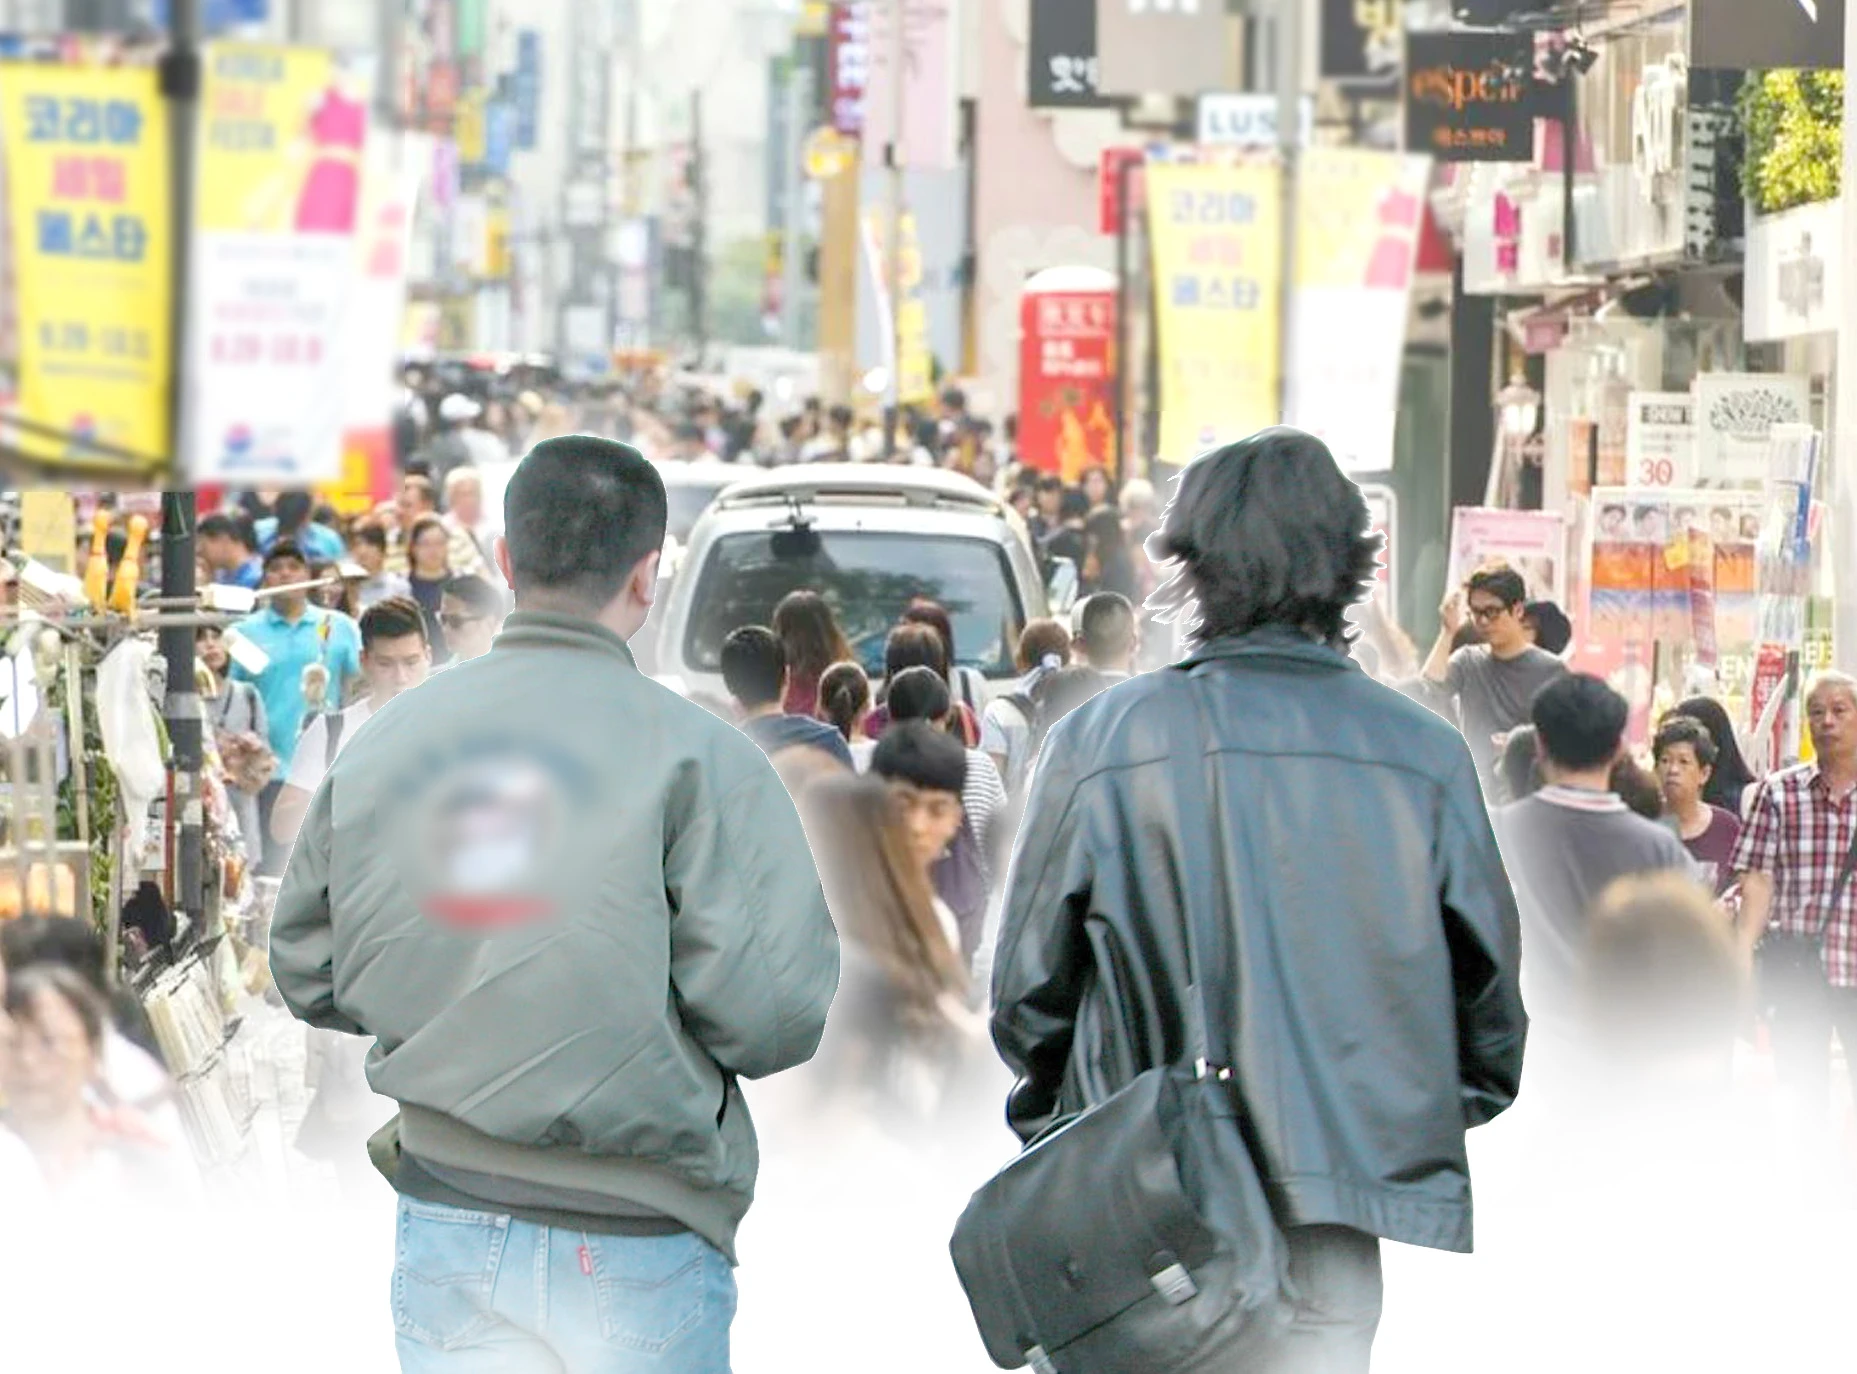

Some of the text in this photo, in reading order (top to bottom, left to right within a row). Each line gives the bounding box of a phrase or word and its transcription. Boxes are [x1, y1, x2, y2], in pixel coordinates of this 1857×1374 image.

[23, 94, 143, 145] 코리아
[1208, 109, 1301, 134] LUS
[1639, 458, 1673, 486] 30
